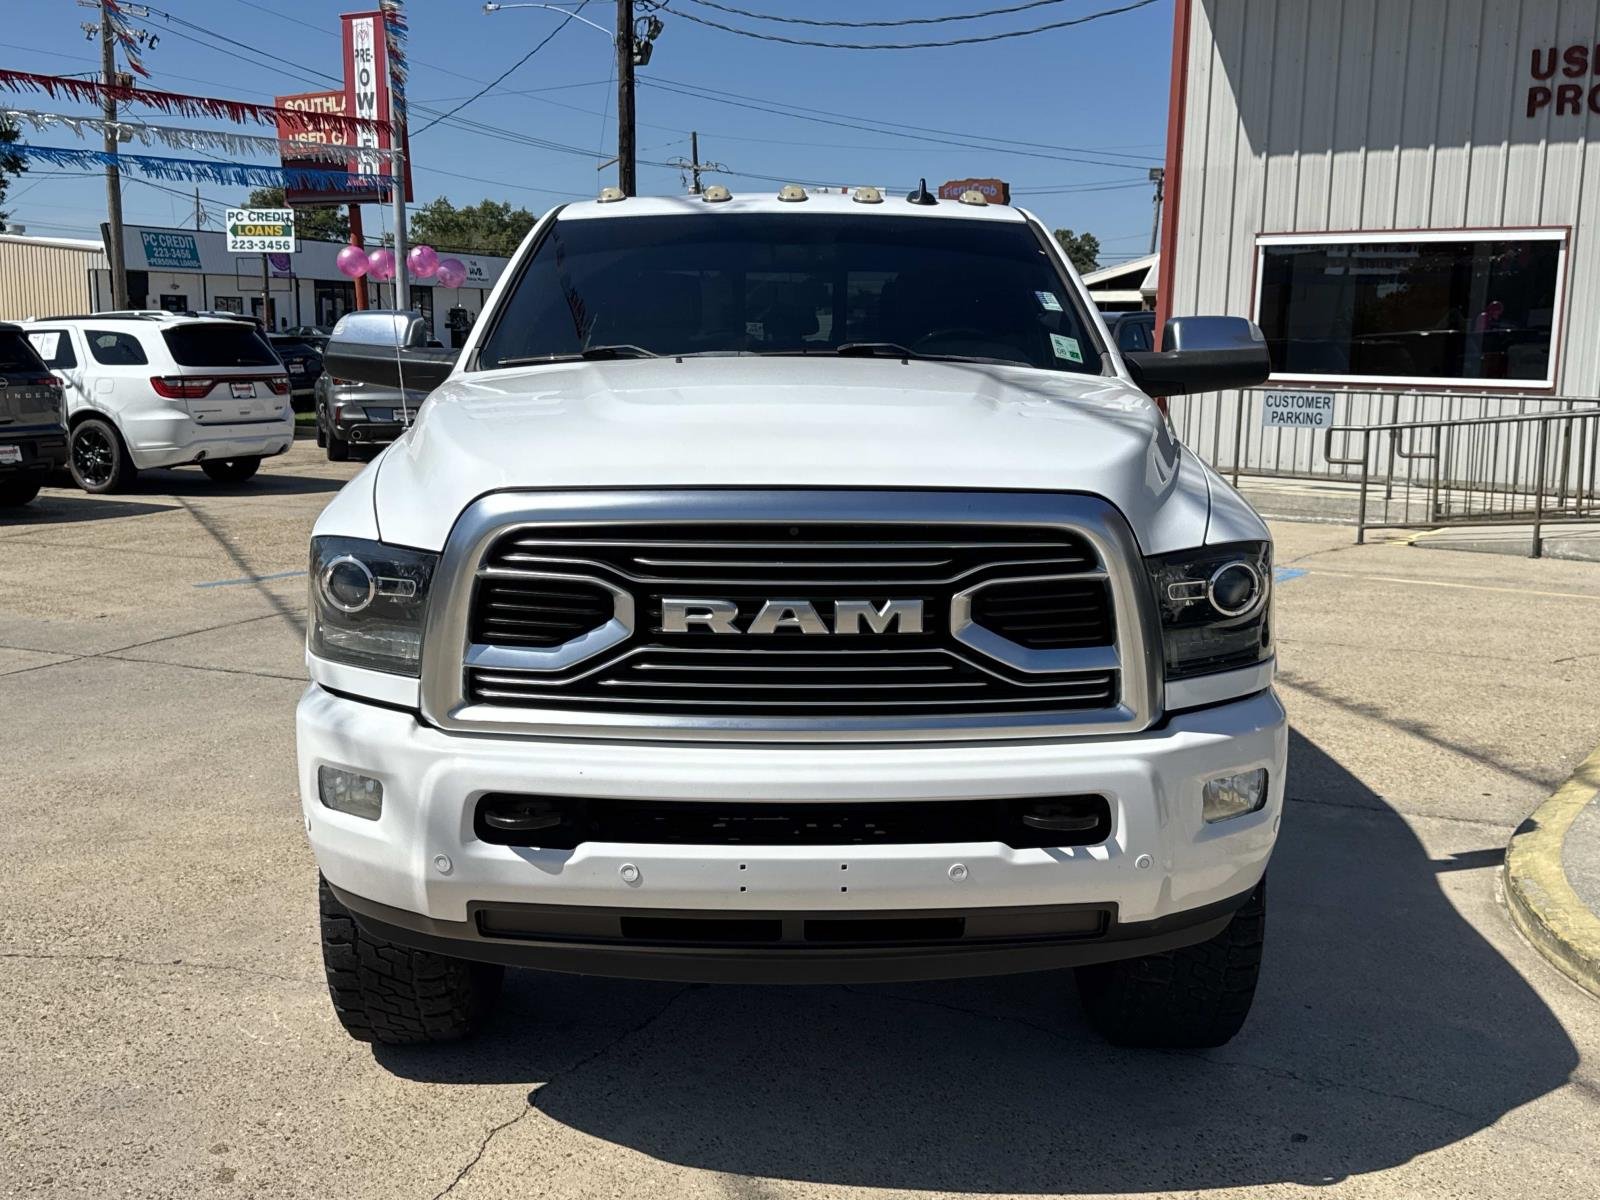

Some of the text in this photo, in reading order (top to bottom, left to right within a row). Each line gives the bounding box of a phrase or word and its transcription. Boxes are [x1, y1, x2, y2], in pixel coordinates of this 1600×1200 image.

[1531, 44, 1600, 80] US
[227, 211, 292, 223] PC CREDIT
[237, 225, 283, 236] LOANS
[142, 234, 194, 249] PC CREDIT
[231, 239, 291, 251] 223-3456
[153, 247, 191, 259] 223-3456
[1265, 394, 1331, 410] CUSTOMER
[1271, 410, 1324, 426] PARKING
[661, 597, 924, 635] RAM
